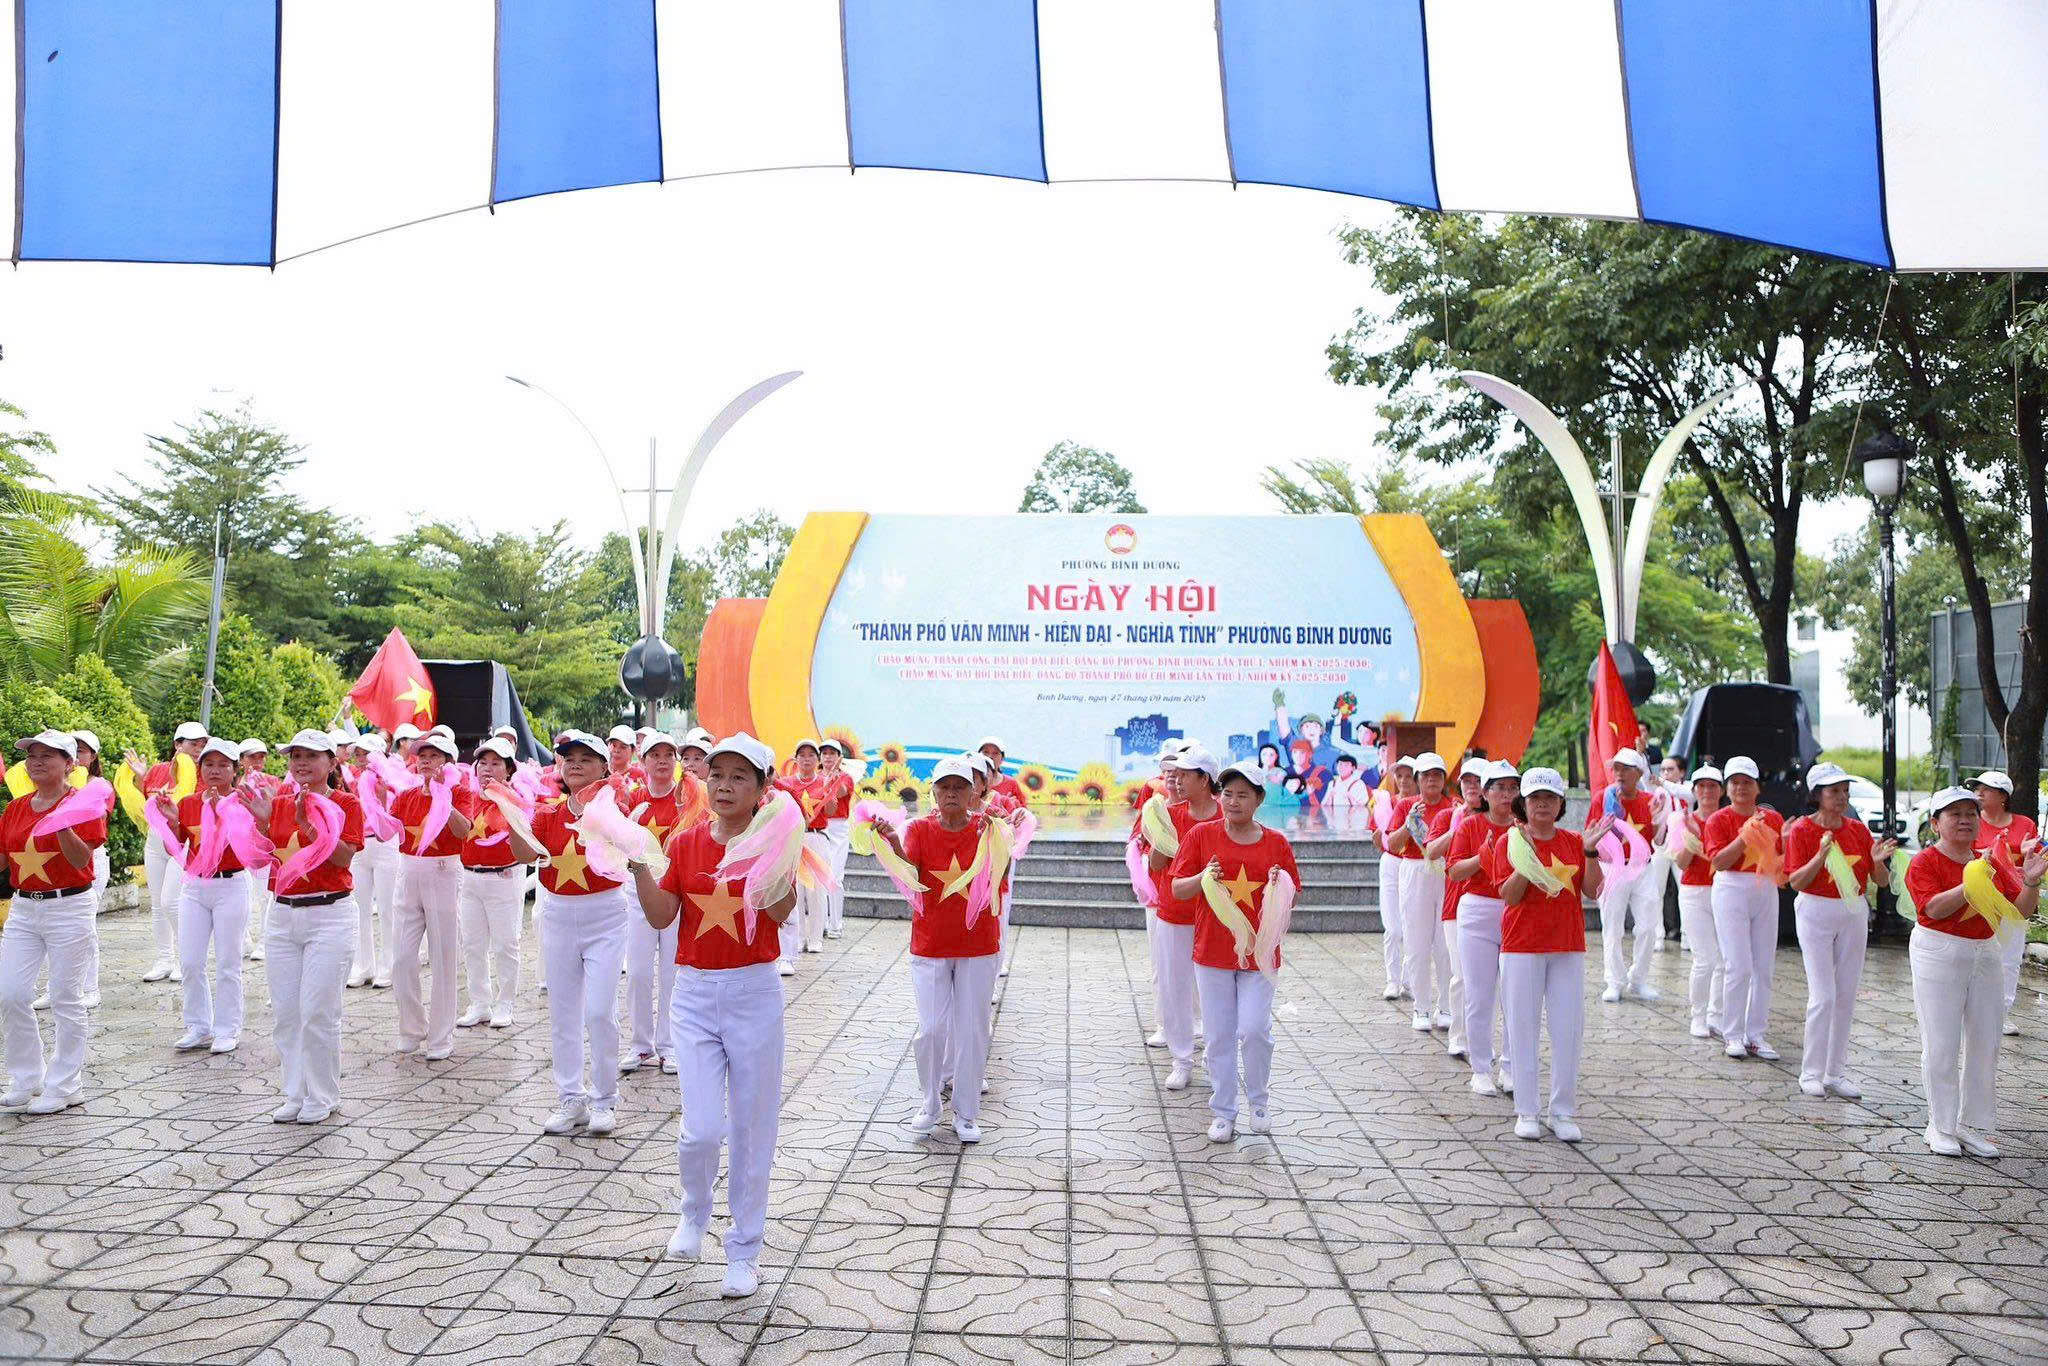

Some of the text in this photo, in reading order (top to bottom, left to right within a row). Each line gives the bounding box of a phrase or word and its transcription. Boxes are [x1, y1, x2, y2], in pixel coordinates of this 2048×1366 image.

[1111, 558, 1139, 570] BÌNH
[1027, 578, 1216, 618] NGÀY HỘI
[916, 616, 947, 642] PHỐ
[951, 619, 983, 642] VĂN
[987, 623, 1030, 642] MINH
[1044, 620, 1082, 647] HIỆN
[1086, 624, 1112, 647] ĐẠI
[1126, 621, 1175, 644] NGHĨA
[1228, 621, 1292, 645] PHƯỜNG
[1296, 622, 1334, 645] BÌNH
[1338, 626, 1392, 645] DƯƠNG
[1110, 694, 1122, 702] 27
[1183, 694, 1206, 702] 2025
